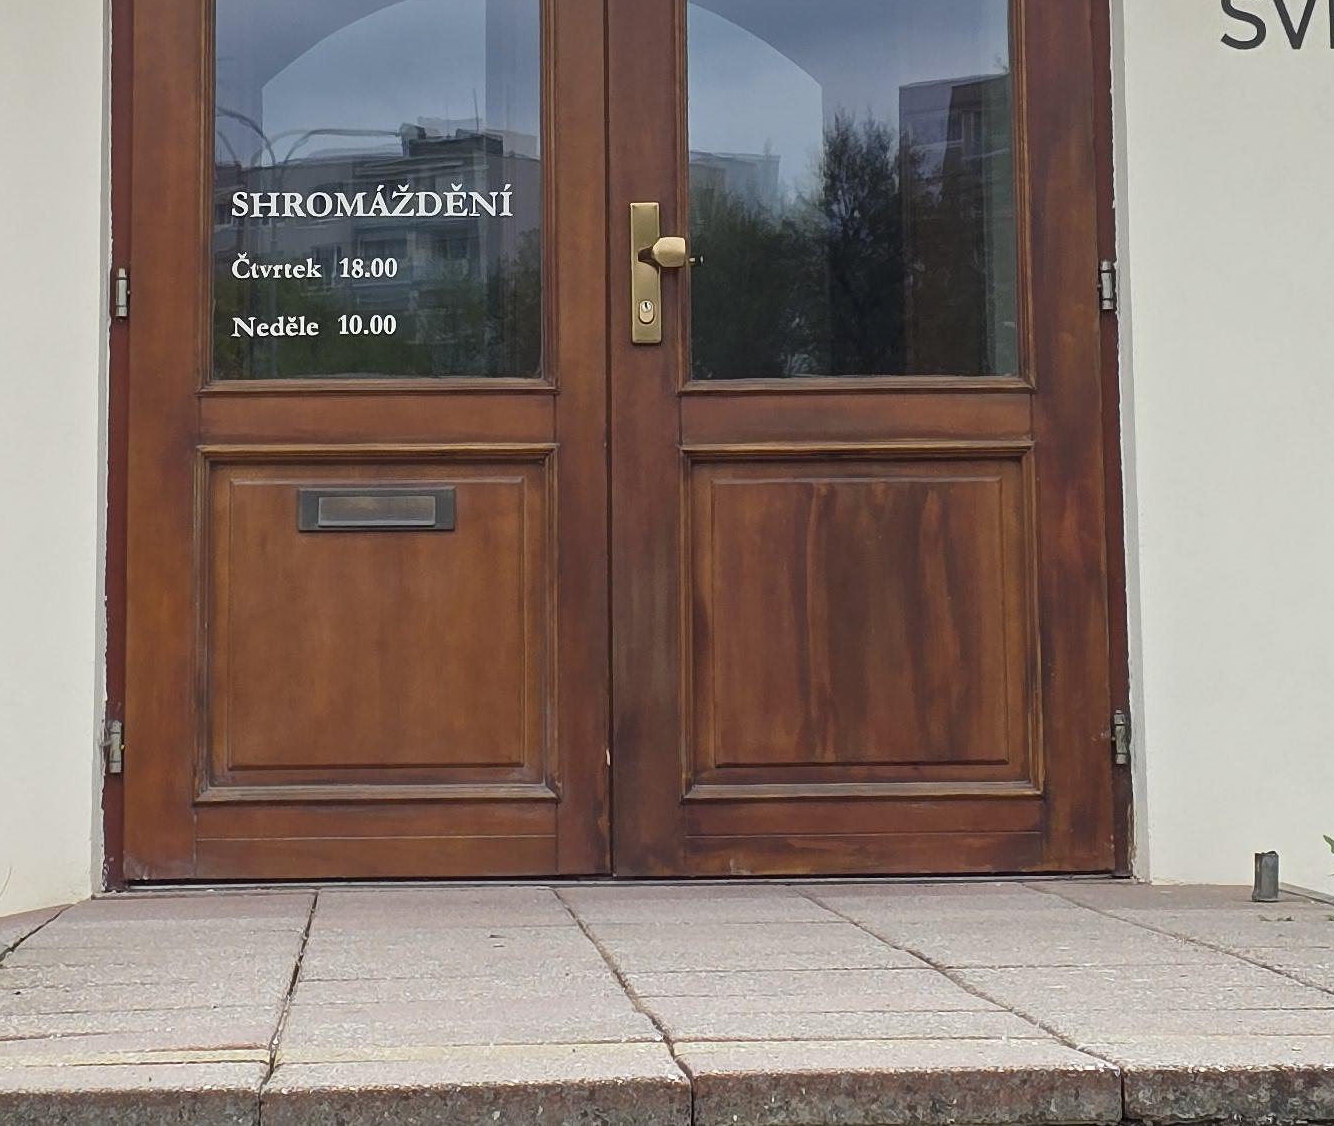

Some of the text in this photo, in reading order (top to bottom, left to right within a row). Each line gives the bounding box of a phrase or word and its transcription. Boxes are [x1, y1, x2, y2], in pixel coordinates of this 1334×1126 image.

[231, 183, 514, 218] SHROMÁŽDĚNÍ
[231, 252, 398, 279] Čtvrtek 18.00
[231, 314, 397, 338] Neděle 10.00
